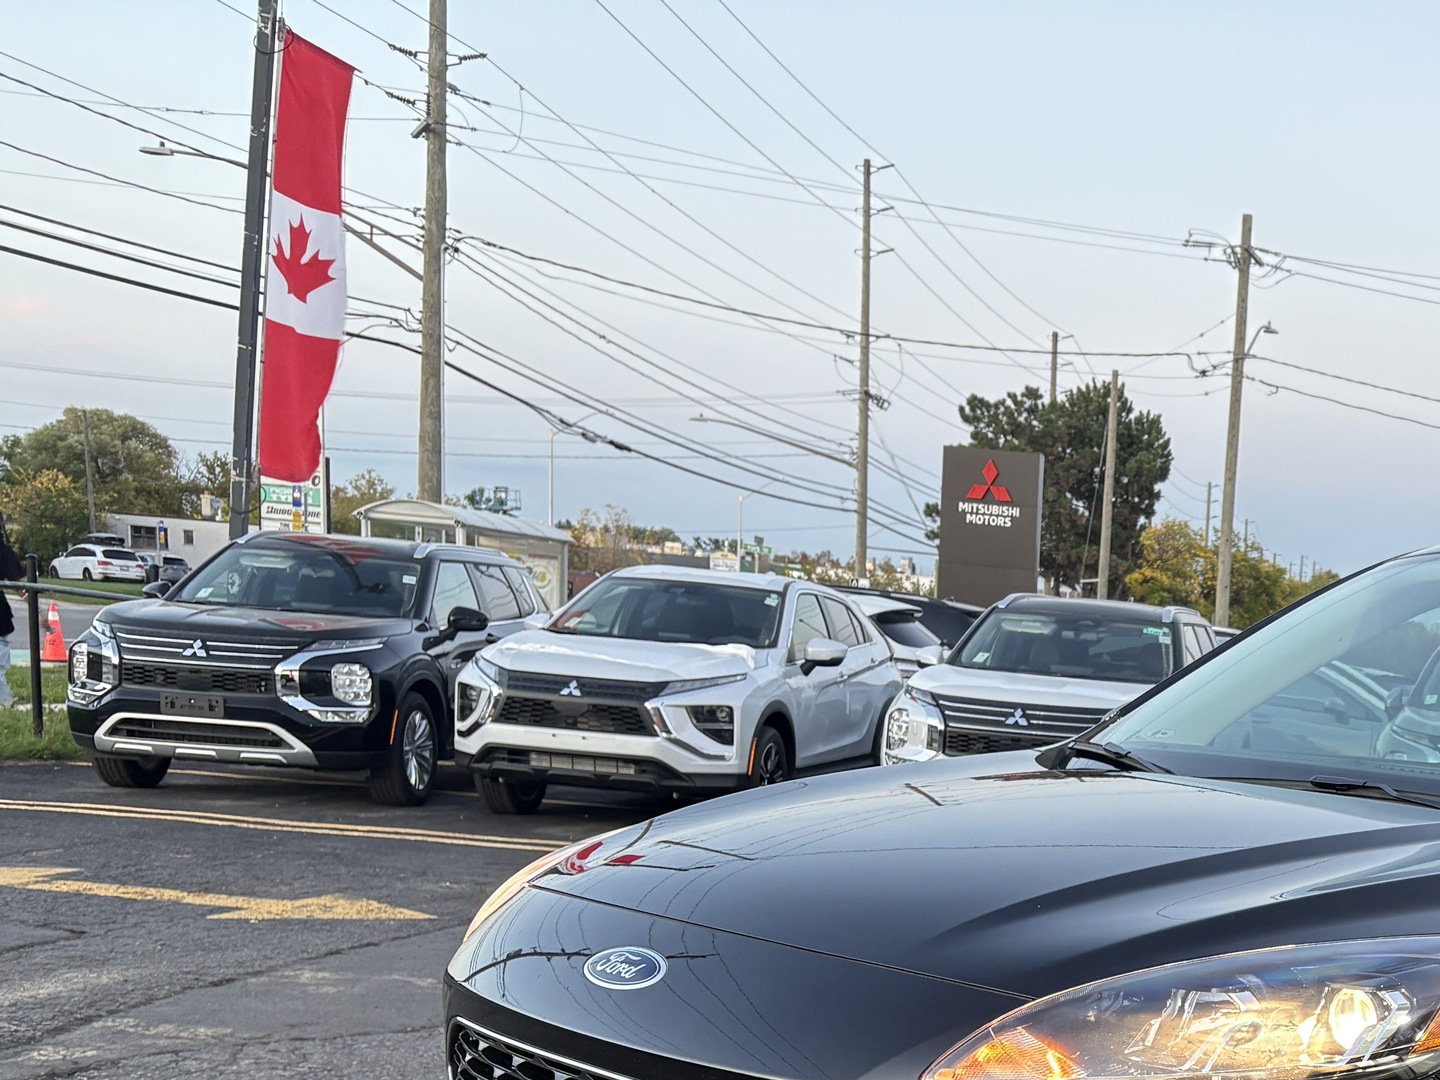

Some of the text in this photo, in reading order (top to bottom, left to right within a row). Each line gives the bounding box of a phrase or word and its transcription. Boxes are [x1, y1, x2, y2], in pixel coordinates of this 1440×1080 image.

[958, 501, 1020, 517] MITSUBISHI
[966, 513, 1012, 527] MOTORS
[596, 952, 646, 979] Ford
